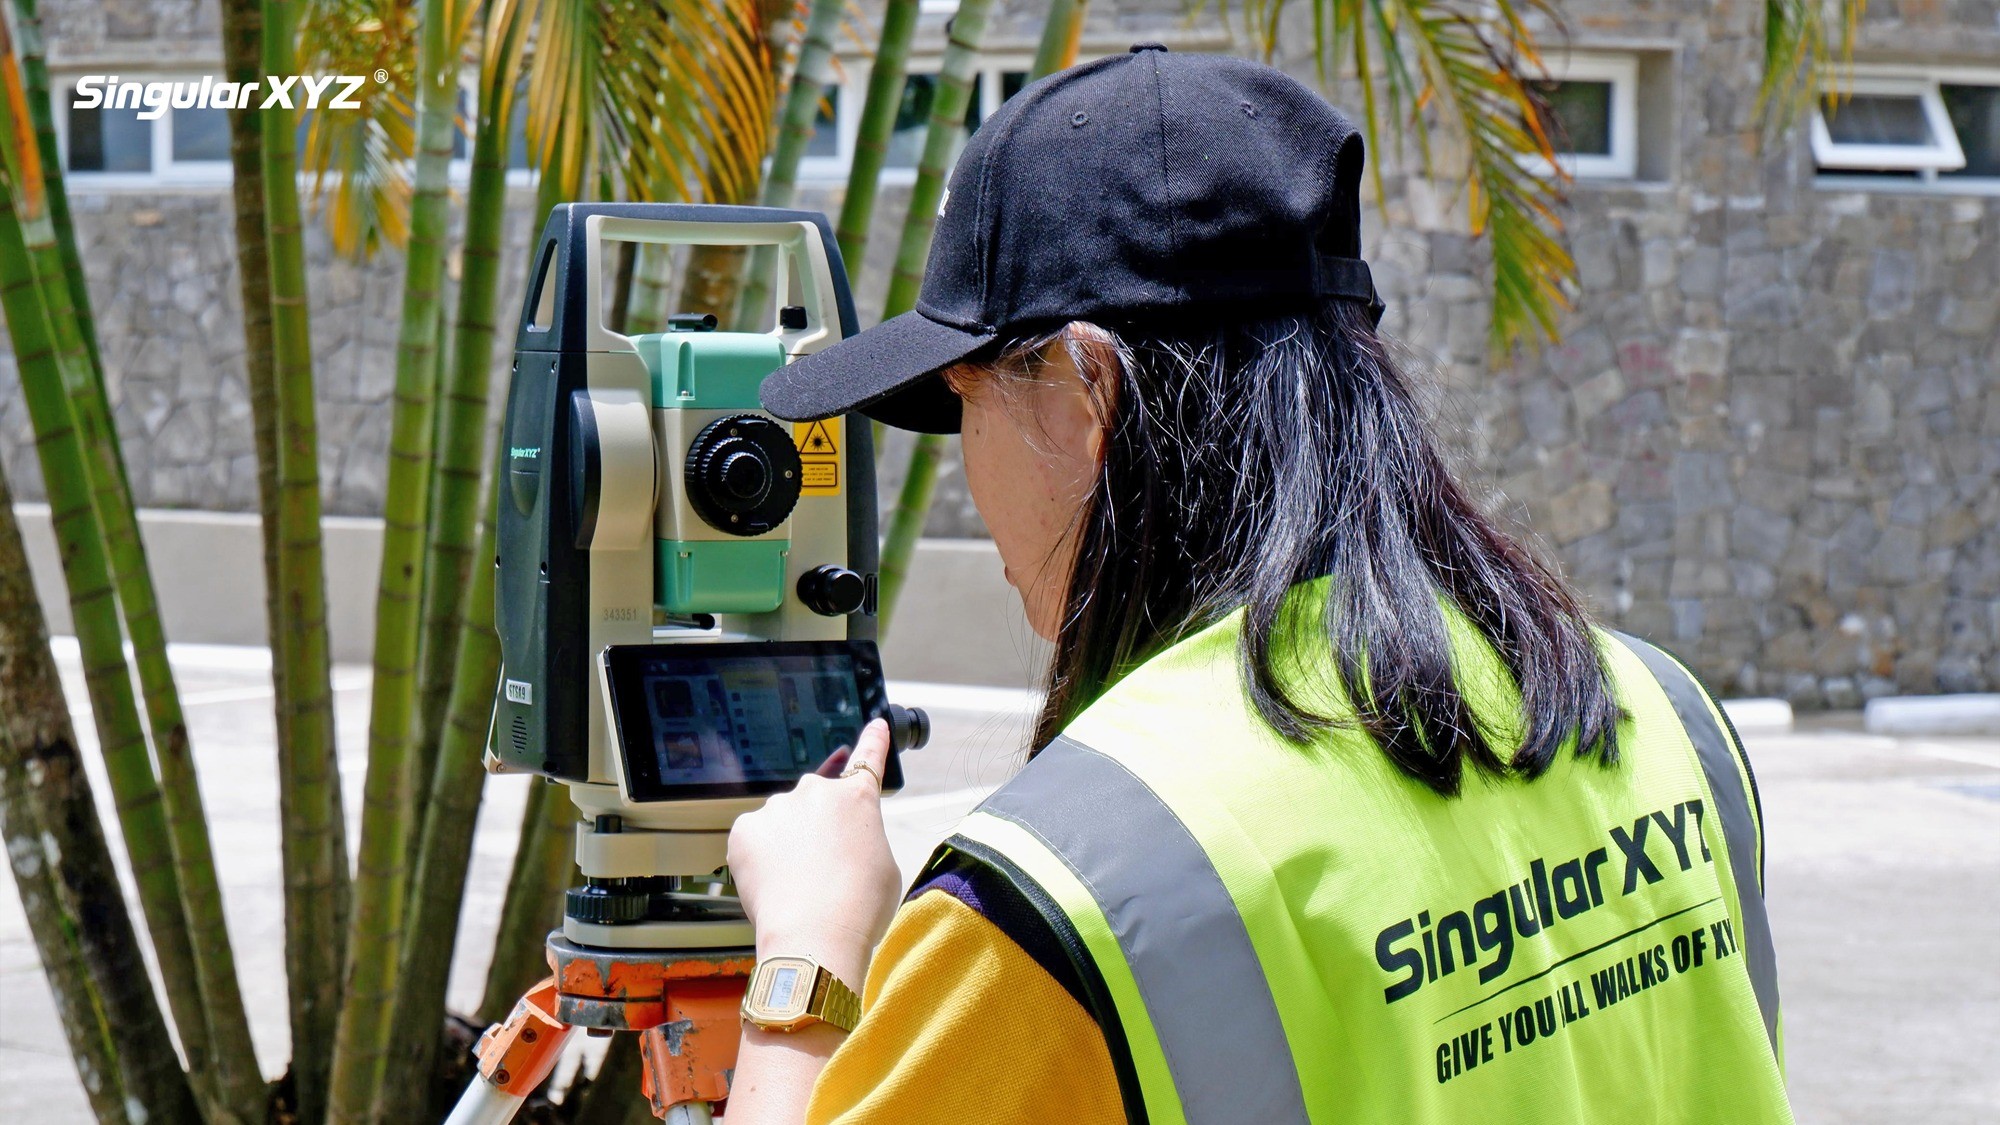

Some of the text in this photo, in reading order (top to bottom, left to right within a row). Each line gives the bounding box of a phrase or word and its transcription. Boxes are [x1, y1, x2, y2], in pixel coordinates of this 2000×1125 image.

[1436, 1022, 1494, 1084] GIVE
[1498, 995, 1557, 1054] YOU
[1557, 980, 1590, 1029] LL
[1591, 949, 1670, 1010] WALKS
[1672, 927, 1707, 974] OF
